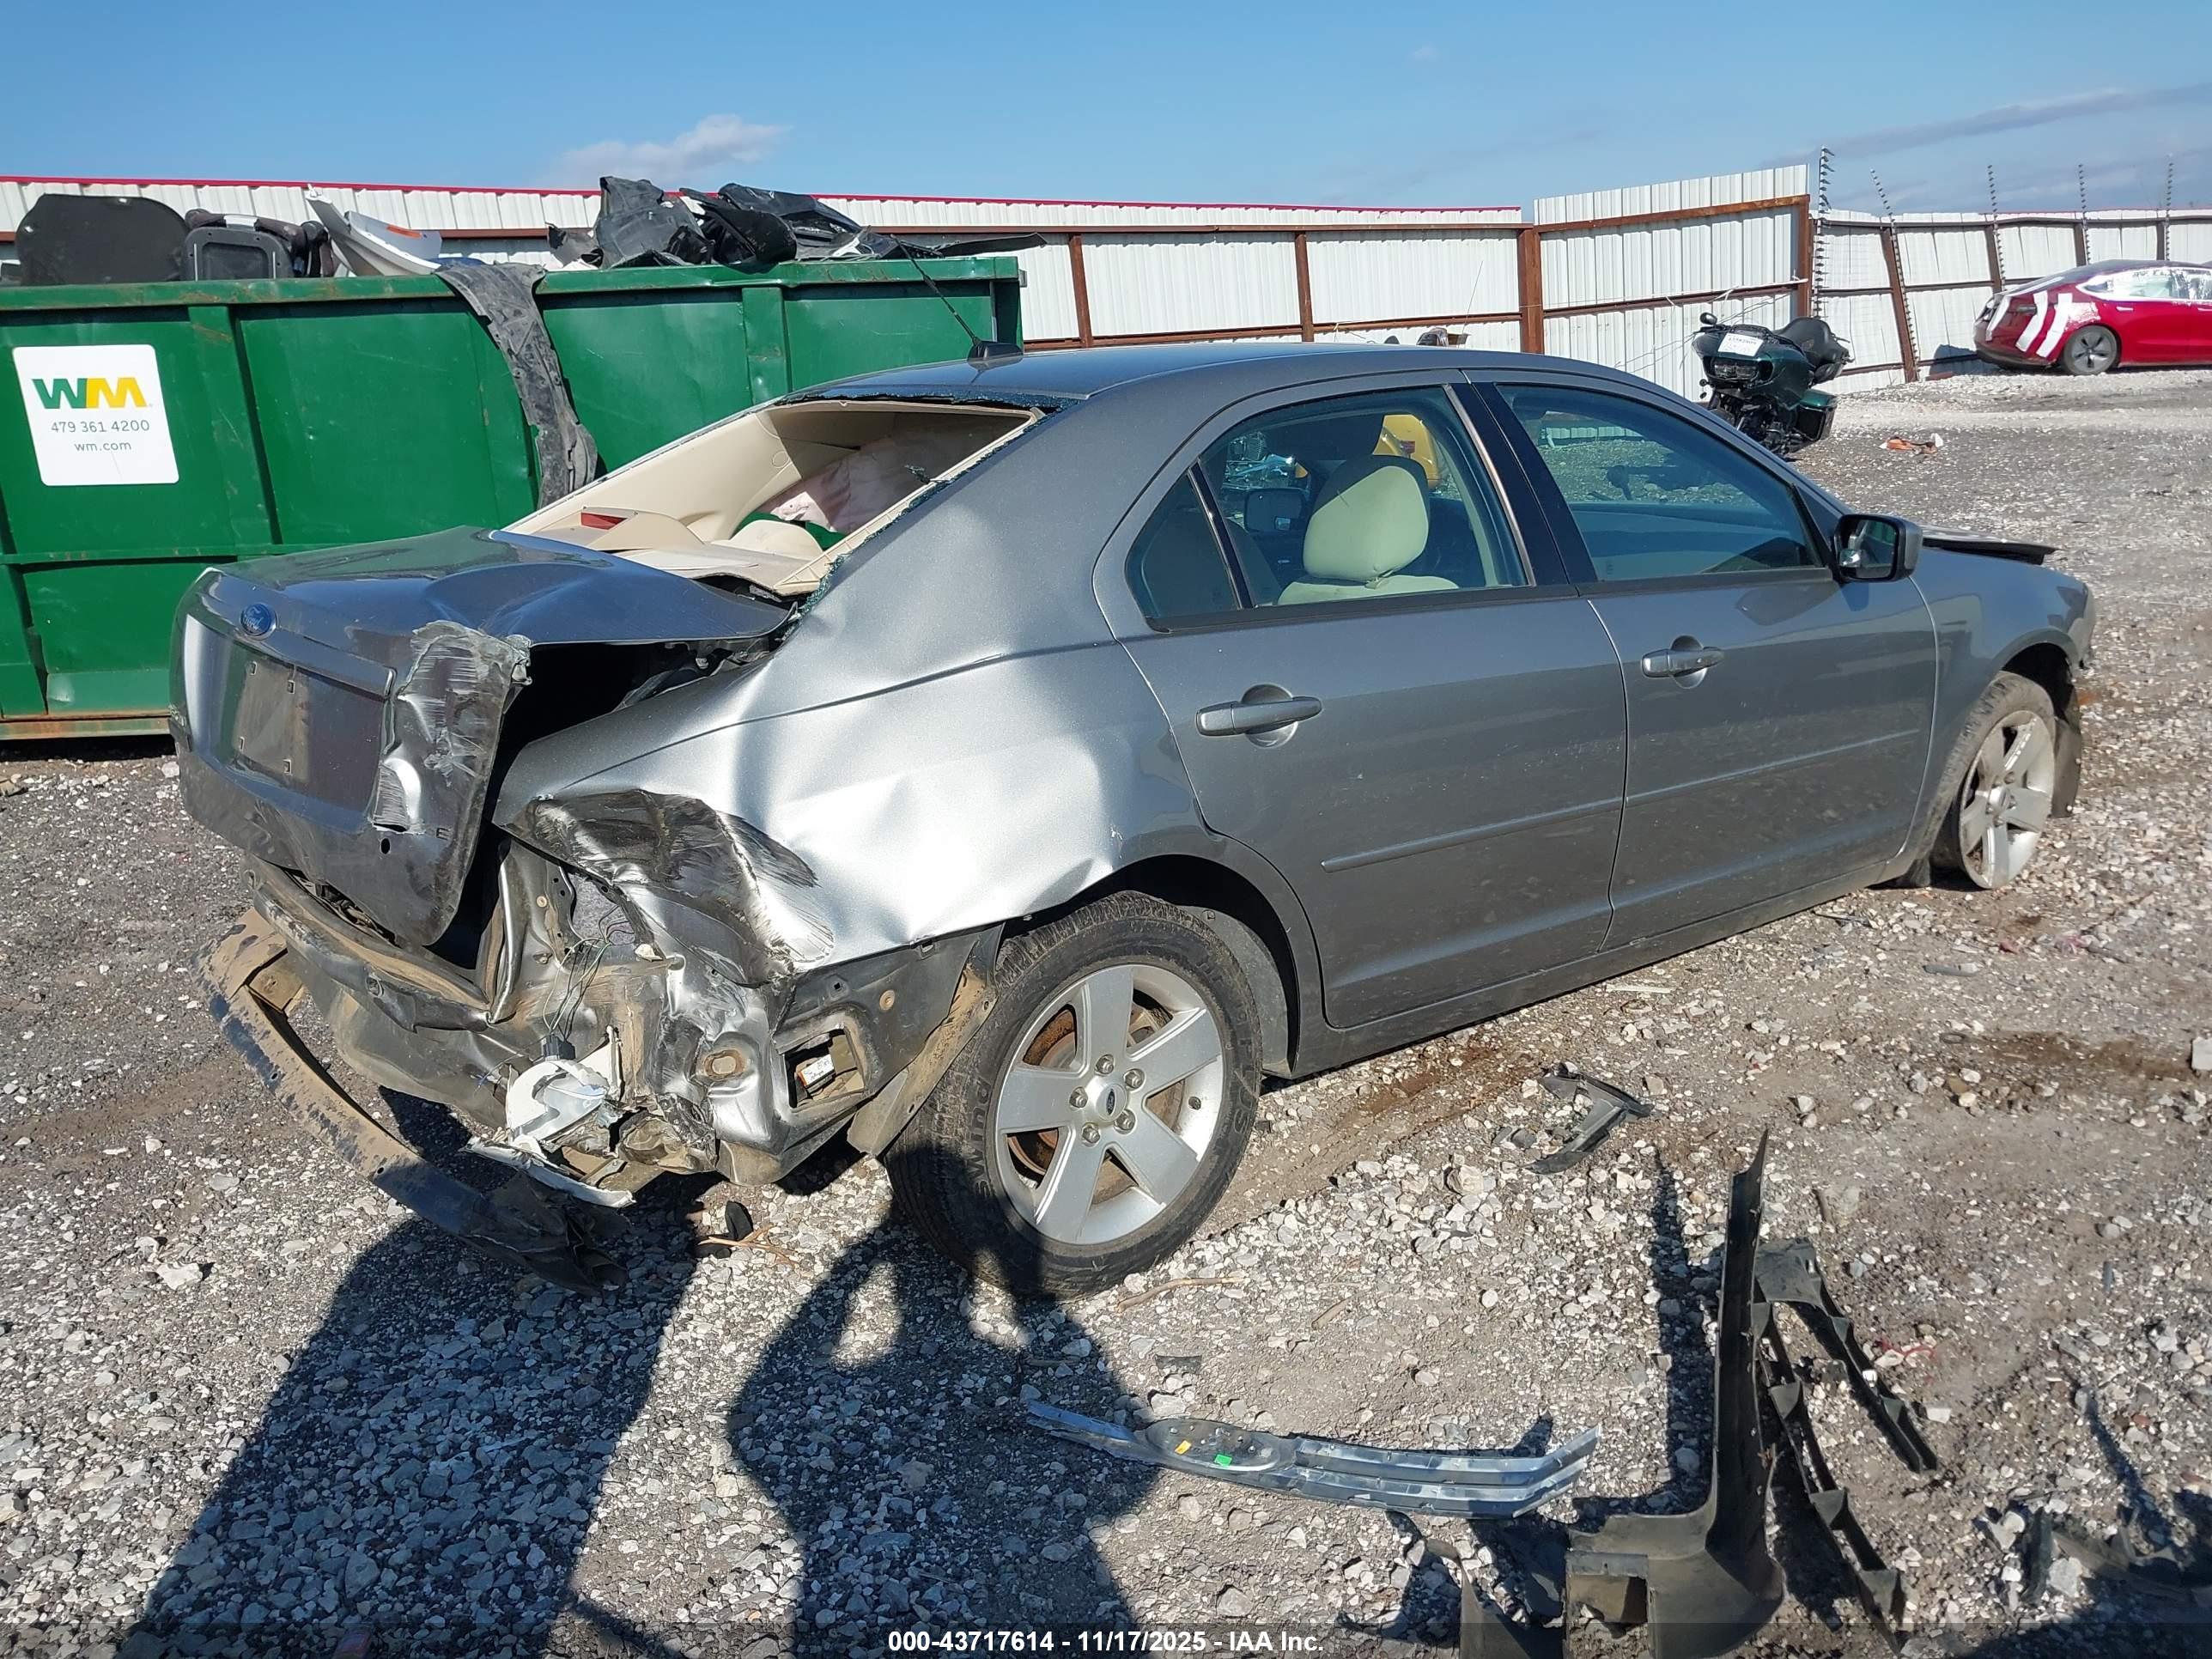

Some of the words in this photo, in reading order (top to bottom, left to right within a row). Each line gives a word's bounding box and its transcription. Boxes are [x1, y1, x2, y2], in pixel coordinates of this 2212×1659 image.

[32, 377, 148, 410] WM
[51, 421, 76, 434] 479
[82, 421, 107, 433] 361
[111, 419, 150, 432] 4200
[74, 441, 132, 452] wm.com
